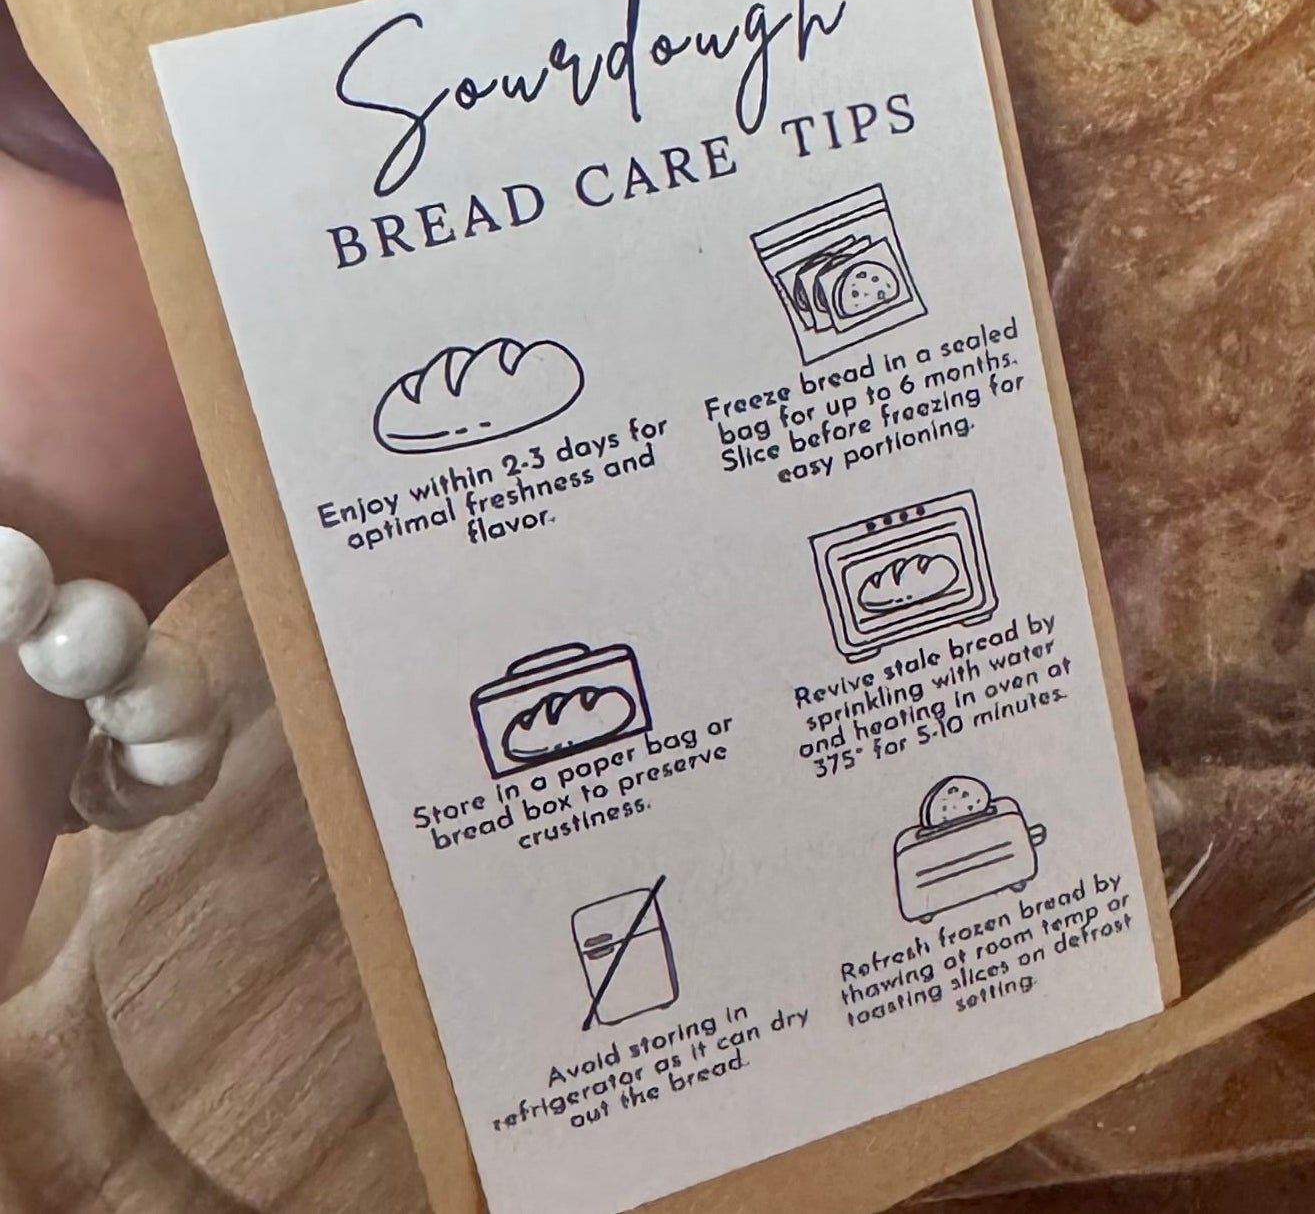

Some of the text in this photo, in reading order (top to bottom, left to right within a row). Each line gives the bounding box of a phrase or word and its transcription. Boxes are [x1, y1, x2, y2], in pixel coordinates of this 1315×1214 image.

[326, 93, 916, 269] BREAD CARE TIPS
[704, 316, 1018, 421] Freeze bread in a sealed
[718, 350, 1018, 445] bag for up to 6 months.
[317, 417, 667, 528] Enjoy within 2-3 days for
[721, 374, 1025, 472] Slice before freezing for
[778, 416, 975, 484] easy portioning.
[348, 442, 656, 550] optimal freshness and
[467, 508, 556, 544] flavor.
[795, 613, 1055, 709] Revive stale bread by
[799, 657, 1071, 758] and heating in oven at
[806, 639, 1054, 732] sprinkling with water
[413, 717, 733, 829] Store in a paper bag or
[813, 747, 863, 778] 375°
[873, 736, 907, 759] for
[917, 715, 963, 744] 5-10
[431, 746, 727, 850] bread box to preserve
[518, 798, 651, 850] crustiness.
[841, 873, 1121, 982] Refresh frozen bread by
[841, 894, 1129, 1006] thawing at room temp or
[847, 913, 1132, 1027] toasting slices on defrost
[492, 1008, 809, 1131] refrigerator as it can dry
[548, 1006, 747, 1087] Avoid storing in
[570, 1100, 609, 1128] out
[621, 1086, 660, 1108] the
